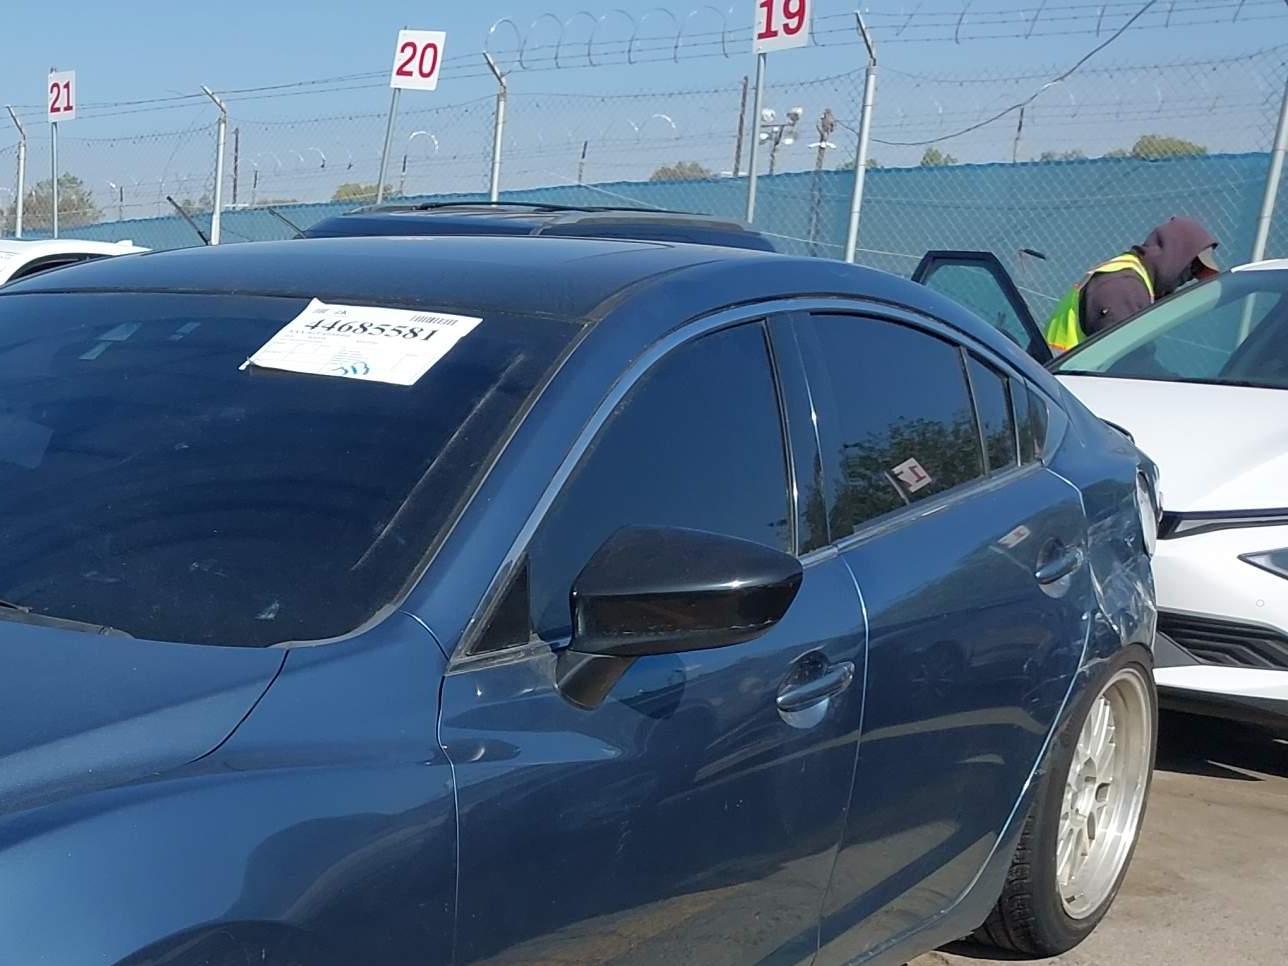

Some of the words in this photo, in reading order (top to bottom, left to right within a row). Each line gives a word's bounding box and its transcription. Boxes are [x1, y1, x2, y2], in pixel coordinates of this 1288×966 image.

[757, 0, 806, 40] 19
[396, 41, 438, 78] 20
[50, 80, 74, 113] 21
[304, 318, 440, 342] 44685581
